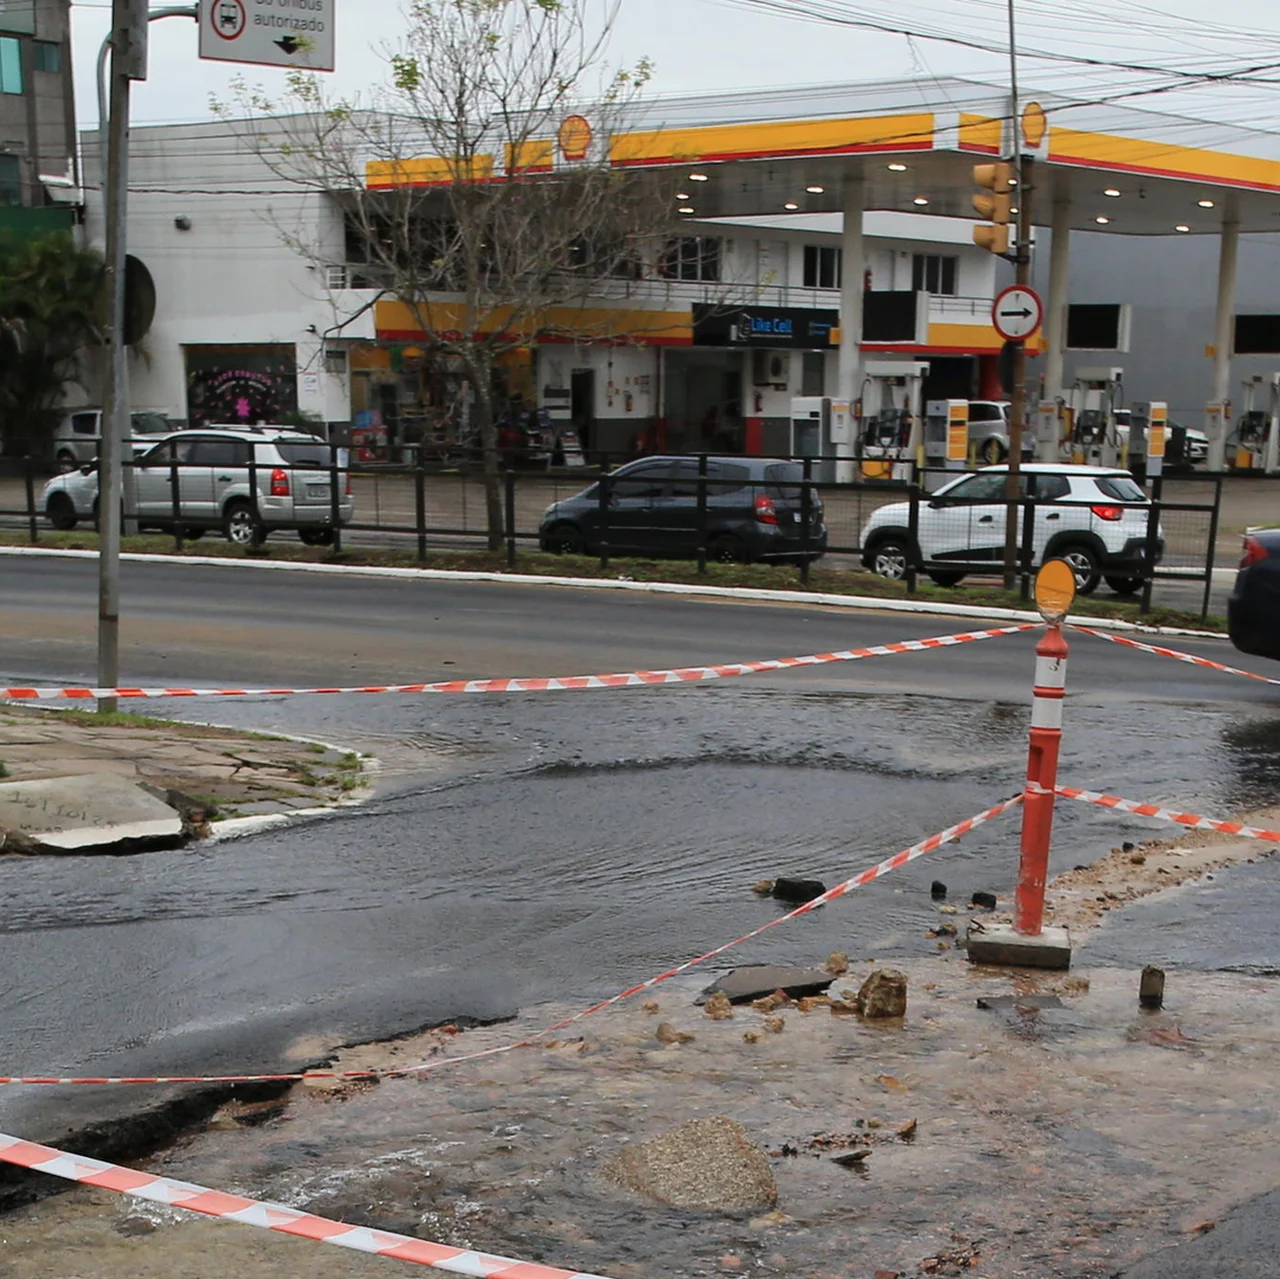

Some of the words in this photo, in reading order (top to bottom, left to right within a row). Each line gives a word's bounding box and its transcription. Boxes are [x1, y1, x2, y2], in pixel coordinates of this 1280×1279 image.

[254, 14, 325, 32] autorizado
[751, 317, 771, 332] Like
[773, 318, 793, 333] Cell
